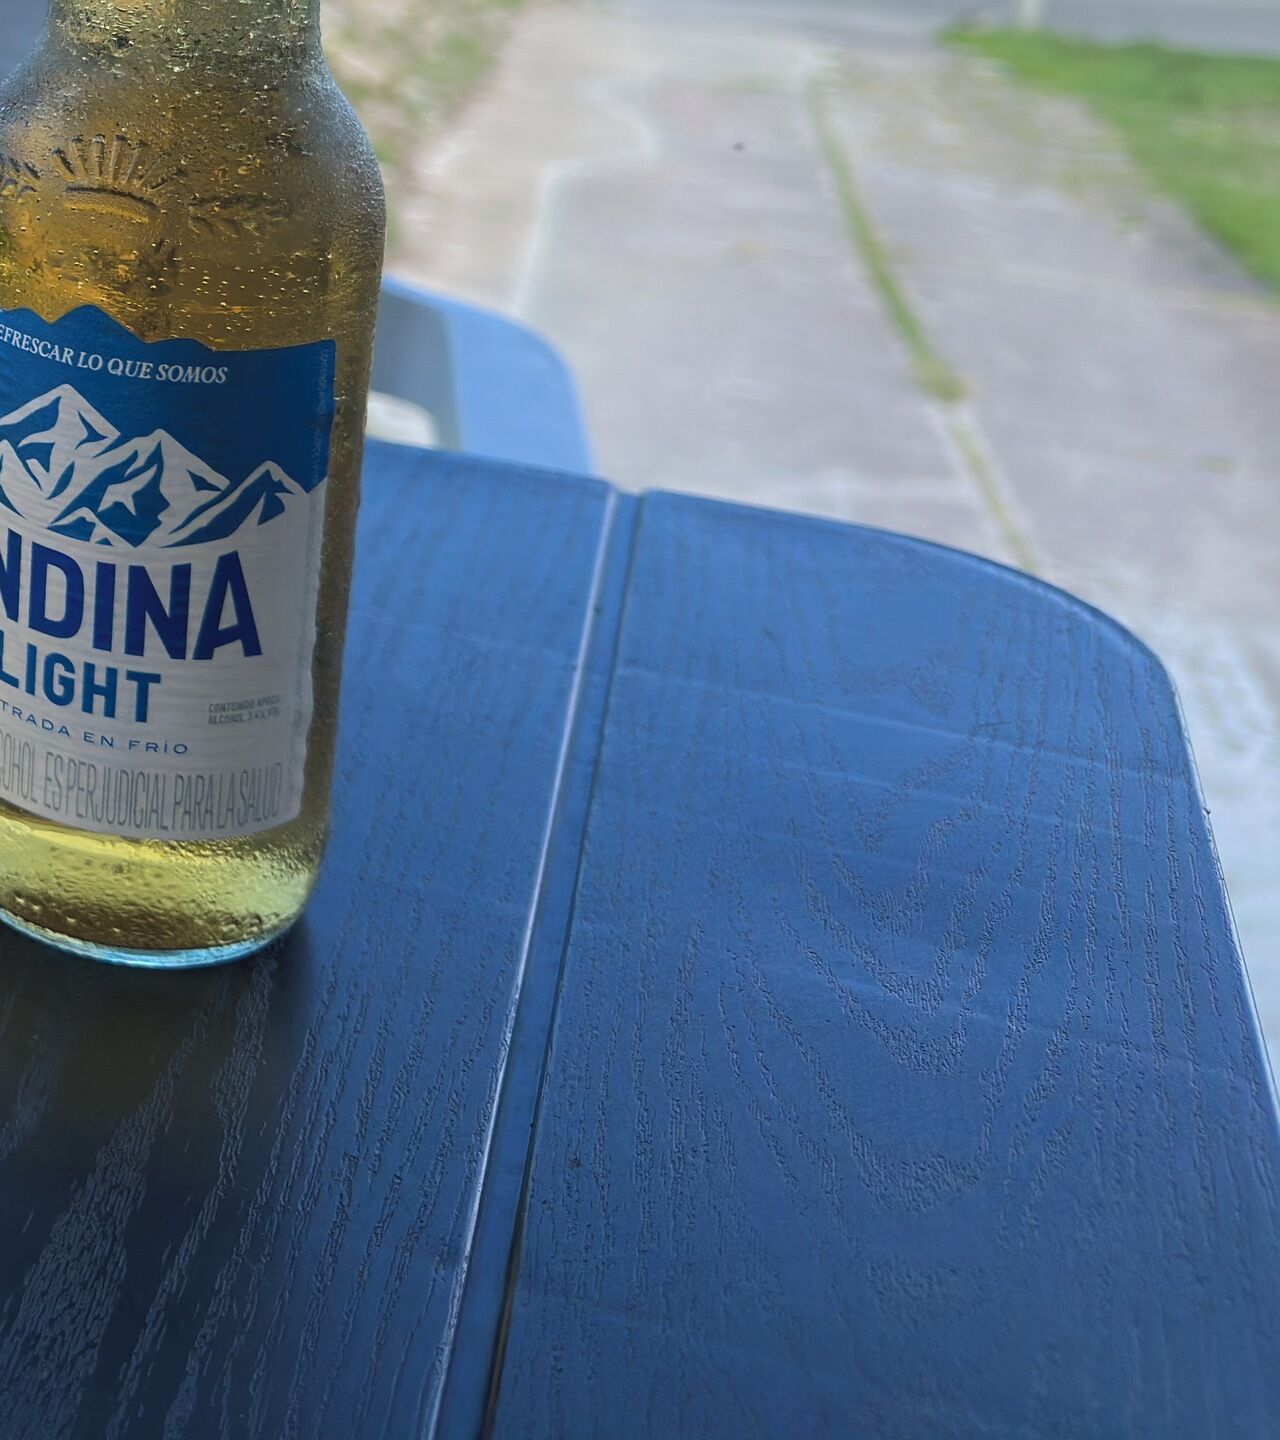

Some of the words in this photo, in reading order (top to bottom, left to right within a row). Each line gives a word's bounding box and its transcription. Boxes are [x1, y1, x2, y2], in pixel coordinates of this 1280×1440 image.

[77, 351, 103, 371] LO
[107, 358, 153, 379] QUE
[155, 364, 228, 384] SOMOS
[84, 731, 114, 747] EN
[128, 739, 188, 754] FRÍO
[43, 751, 63, 811] ES
[65, 758, 169, 832] PERJUDICIAL
[172, 773, 213, 832] PARA
[216, 772, 234, 829] LA
[237, 762, 282, 826] SALUD
